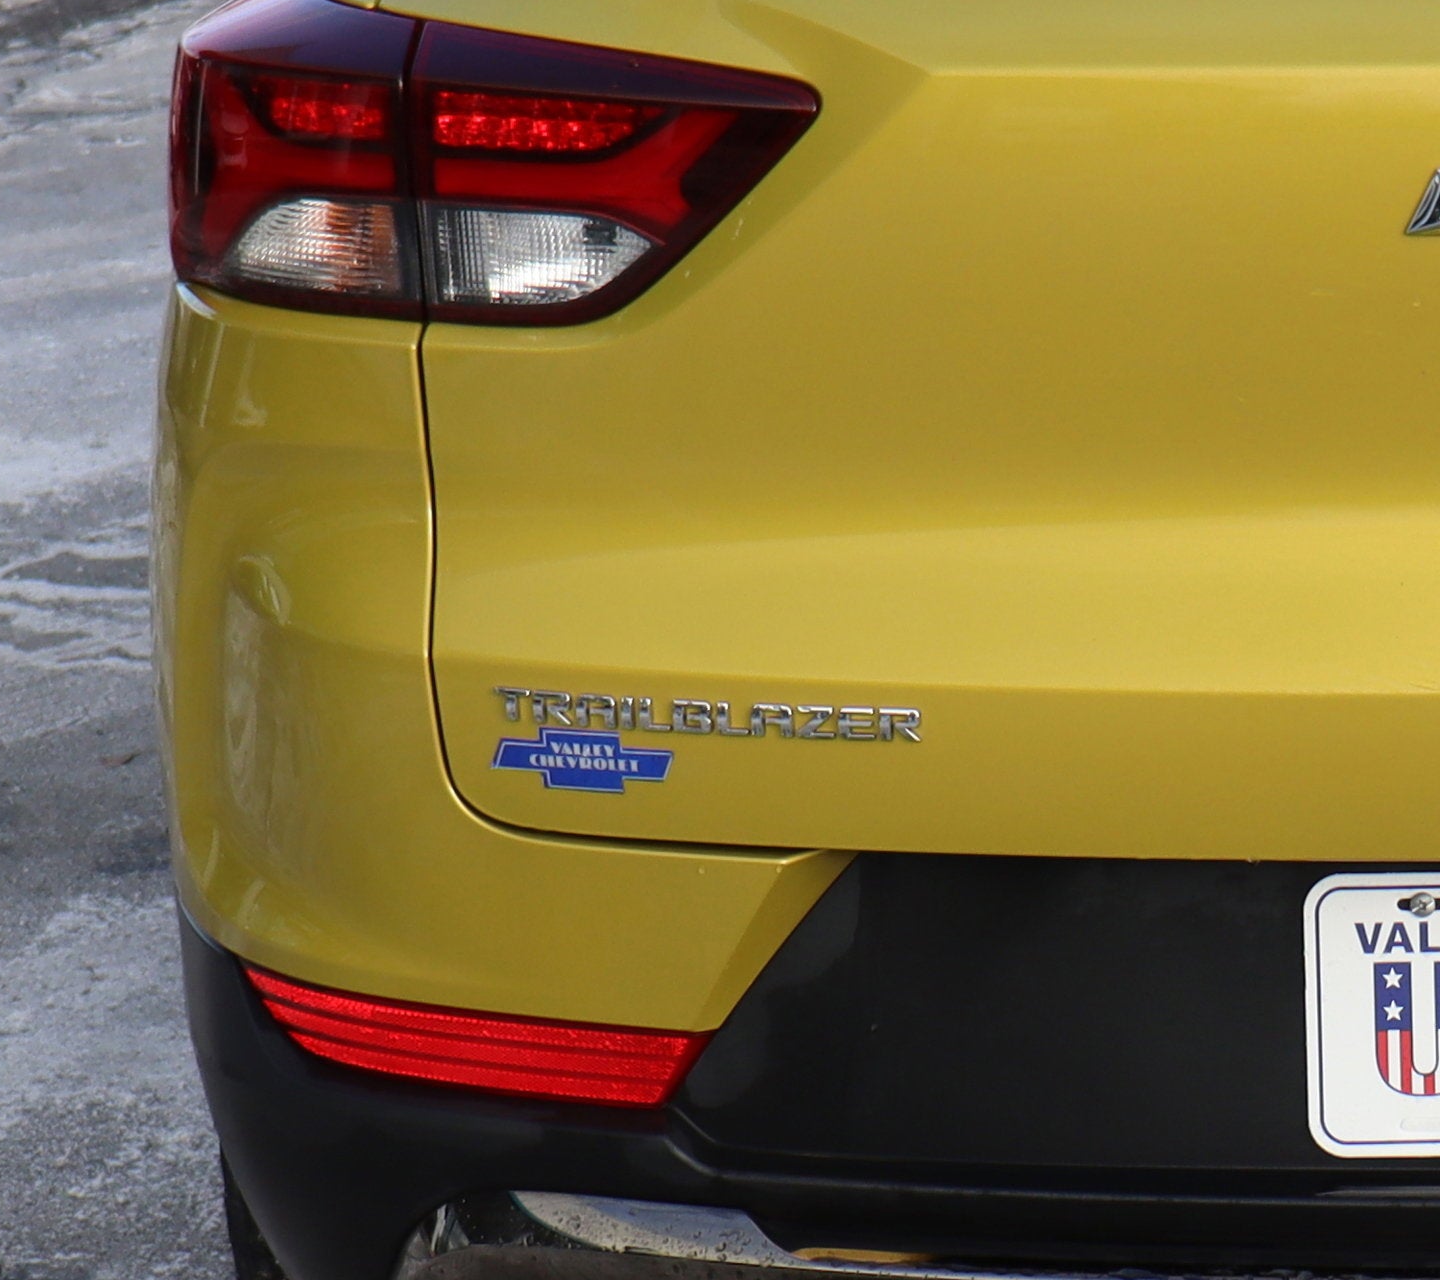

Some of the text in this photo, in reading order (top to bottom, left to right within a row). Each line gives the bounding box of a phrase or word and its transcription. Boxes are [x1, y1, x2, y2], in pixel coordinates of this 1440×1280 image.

[492, 686, 923, 743] TRAILBLAZER
[549, 741, 616, 758] VALLEY
[528, 753, 640, 773] CHEVROLET
